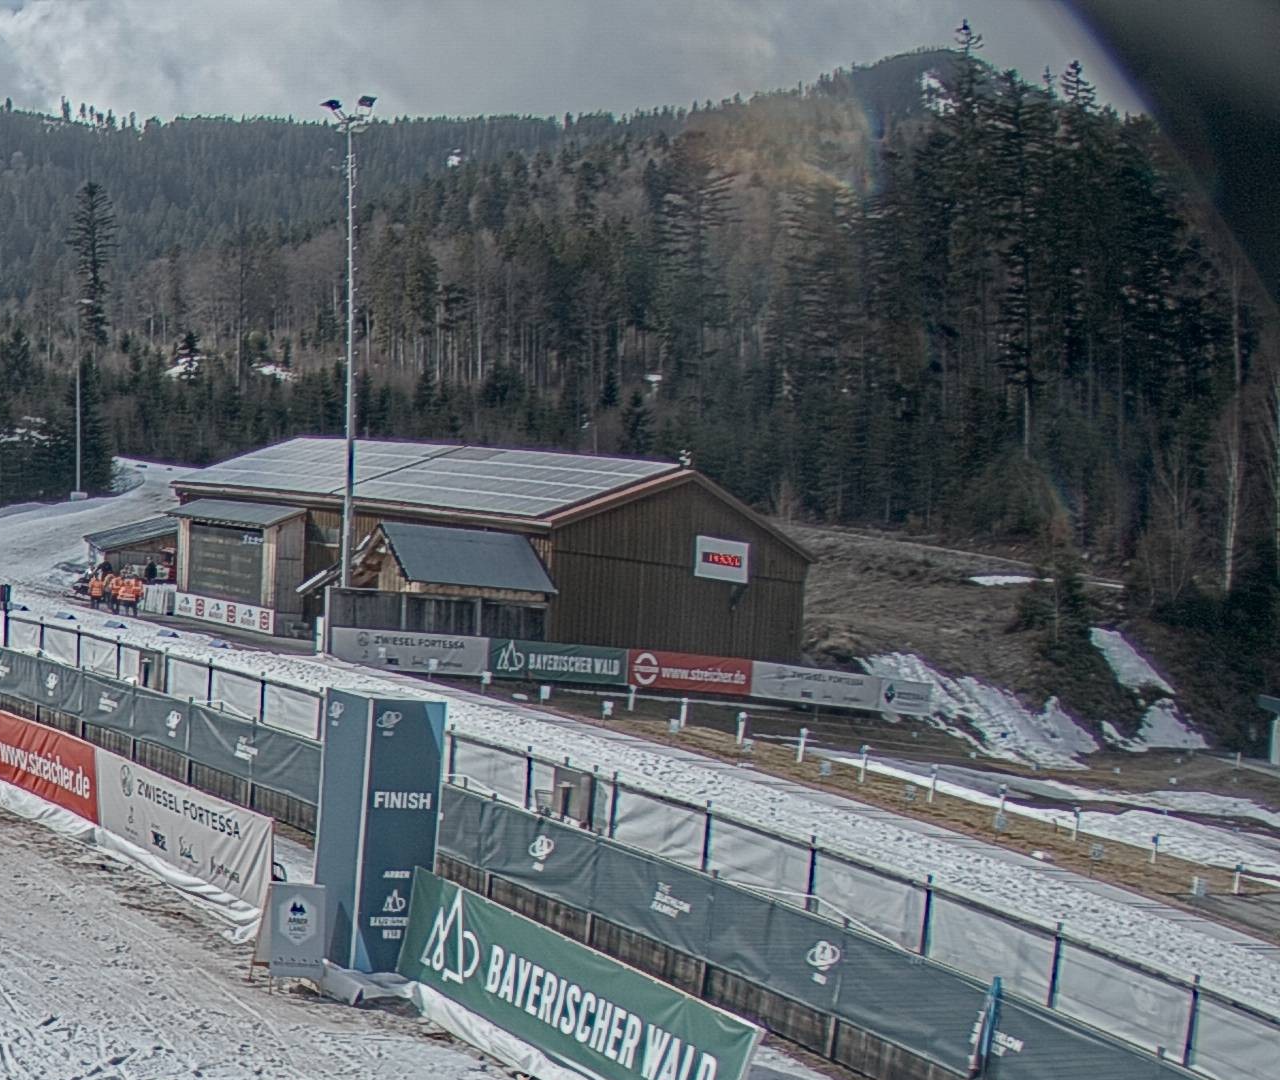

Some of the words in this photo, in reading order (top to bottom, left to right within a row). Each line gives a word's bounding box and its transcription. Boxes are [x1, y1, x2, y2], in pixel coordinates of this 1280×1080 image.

[528, 652, 592, 674] BAYERISCHER
[594, 657, 620, 676] WALD
[661, 666, 746, 685] www.streicher.de
[137, 778, 181, 814] ZWIESEL
[182, 799, 242, 841] FORTESSA
[373, 791, 433, 810] FINISH
[485, 943, 642, 1070] BAYERISCHER
